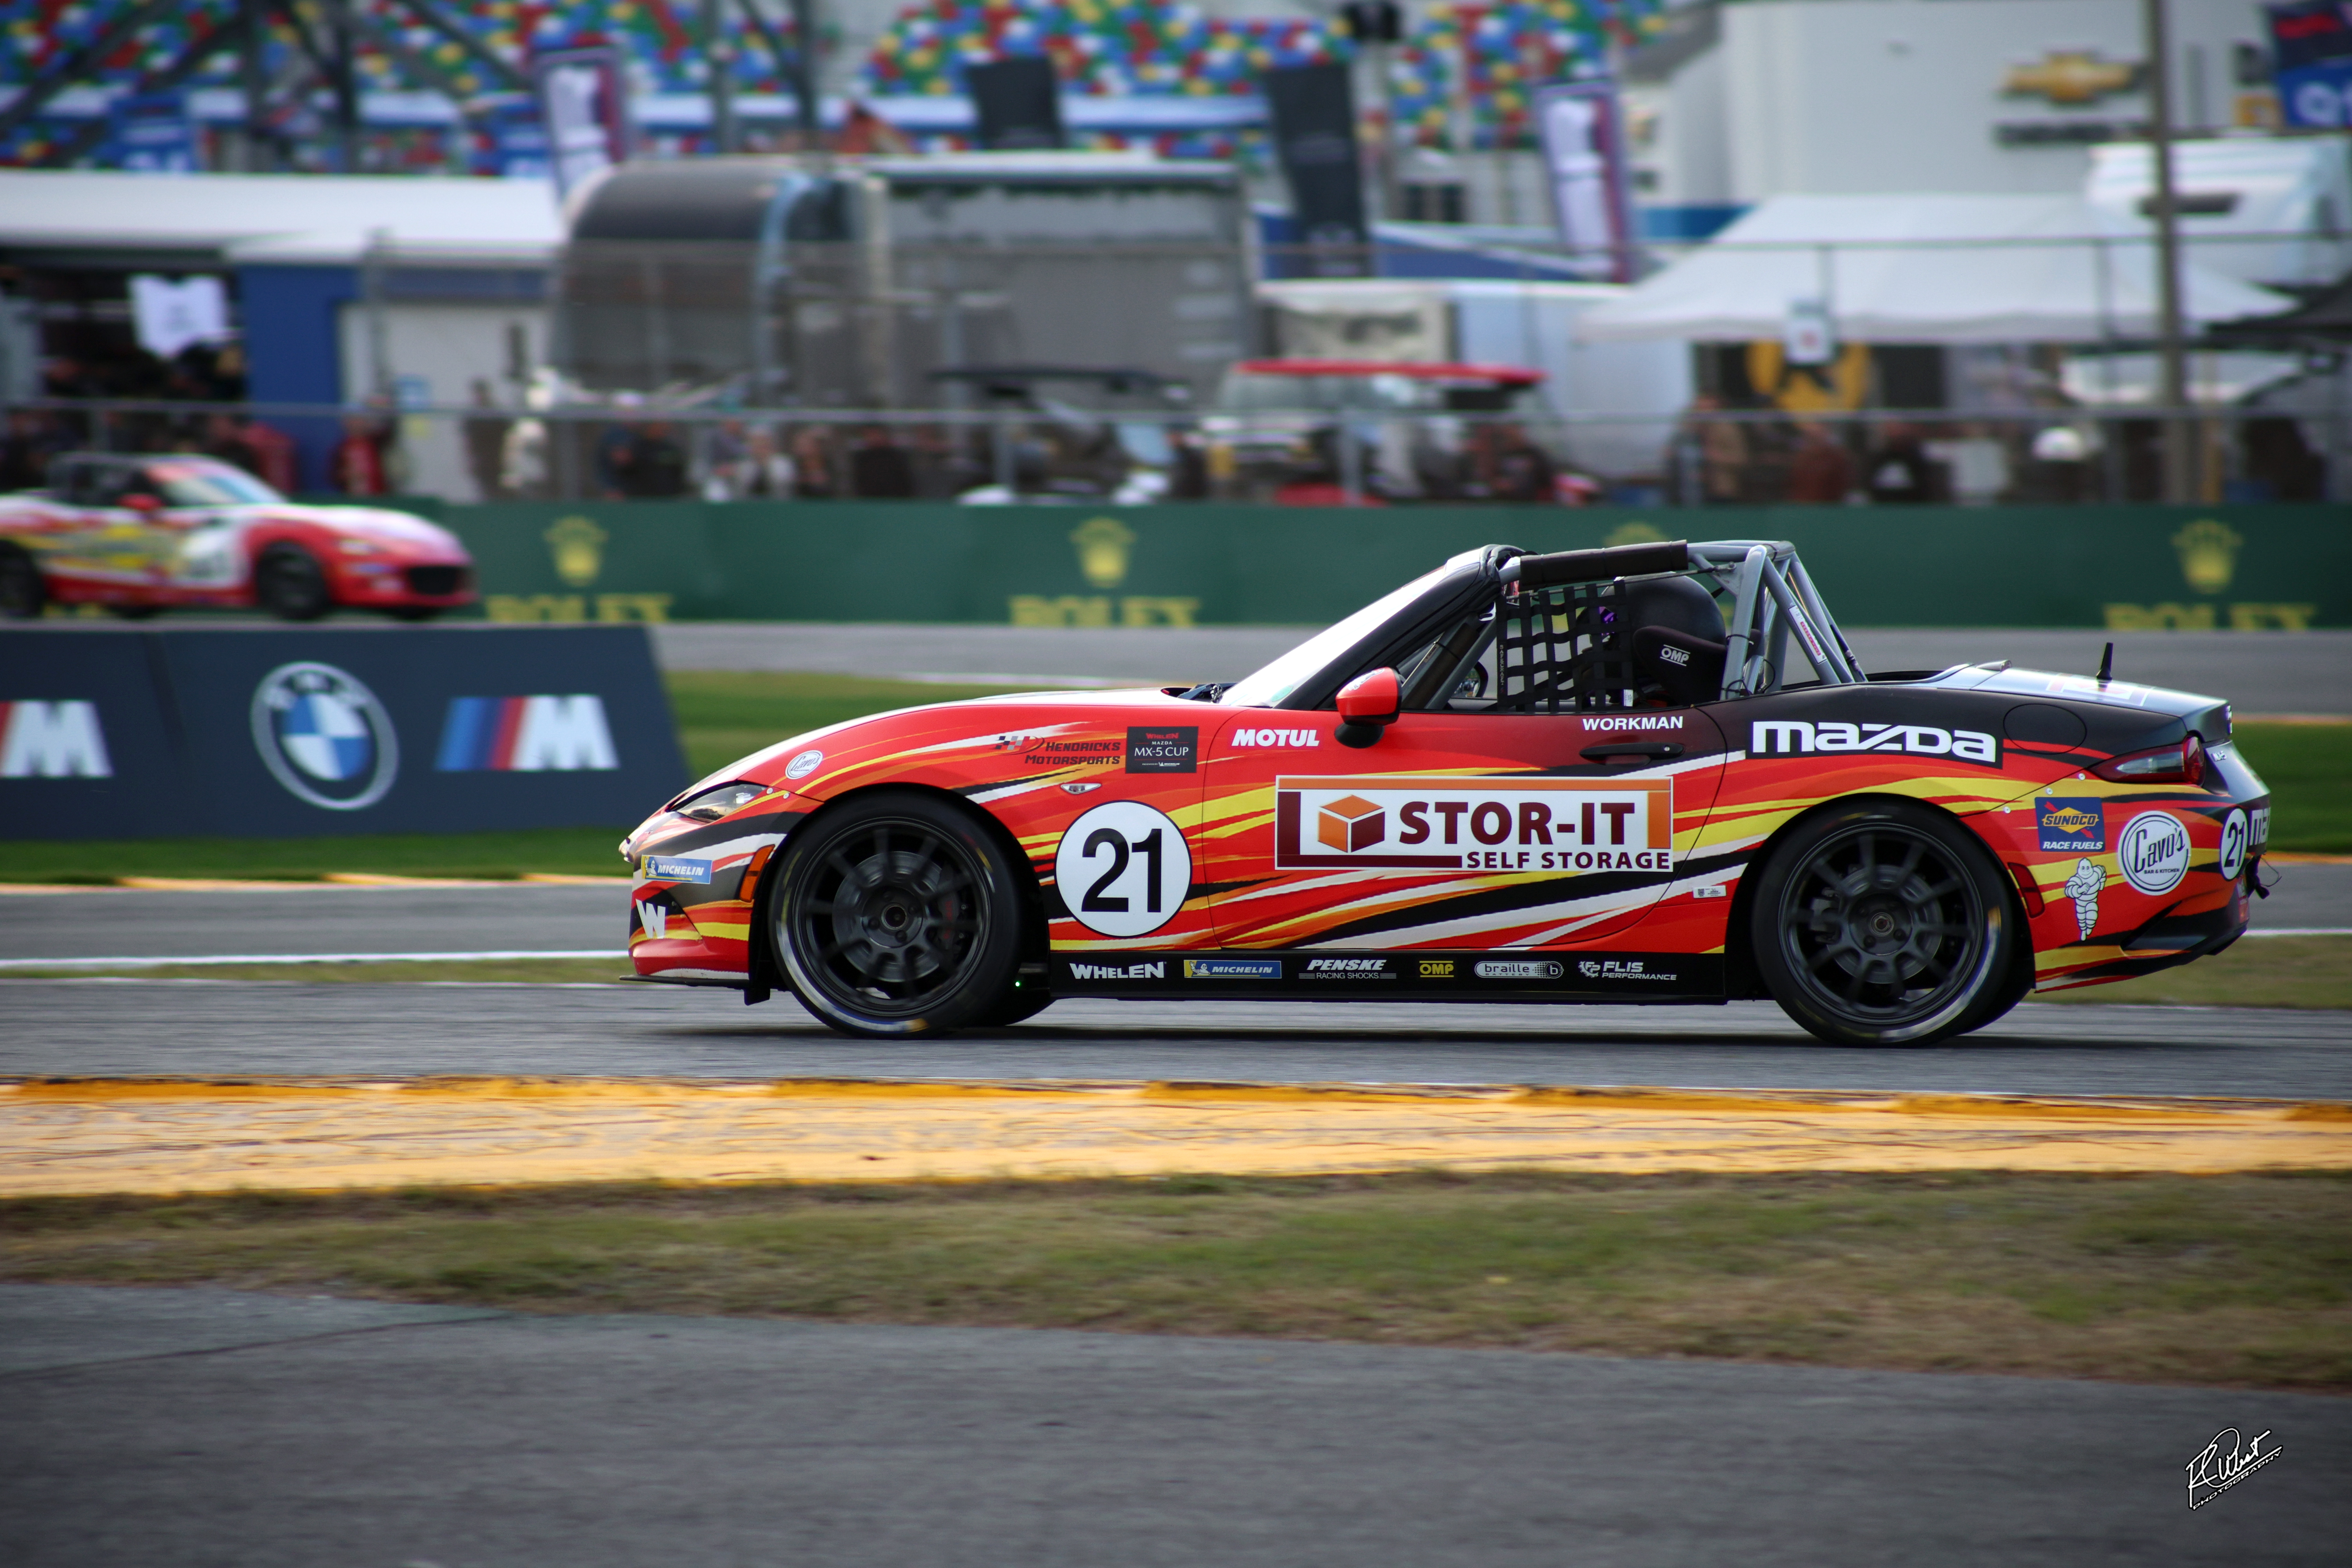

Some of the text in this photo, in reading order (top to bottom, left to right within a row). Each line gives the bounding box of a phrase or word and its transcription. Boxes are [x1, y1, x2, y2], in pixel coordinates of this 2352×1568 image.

[1661, 648, 1690, 663] OMP
[1583, 716, 1683, 730] WORKMAN
[1231, 729, 1320, 747] MOTUL
[1045, 742, 1121, 751] HENDRICKS
[1134, 747, 1189, 757] MX-5 CUP
[1025, 755, 1120, 765] MOTORSPORTS
[1399, 801, 1635, 845] STOR-IT
[2044, 815, 2098, 826] SUNOCO
[2043, 841, 2103, 849] RACE FUELS
[2134, 827, 2185, 873] Cavo's
[2223, 822, 2245, 868] 21
[1467, 851, 1670, 869] SELF STORAGE
[657, 865, 704, 876] MICHELIN
[1081, 828, 1162, 913] 21
[635, 898, 666, 939] W
[1069, 961, 1164, 979] WHELEN
[1307, 960, 1387, 970] PENSKE
[1419, 964, 1454, 975] OMP
[1485, 964, 1530, 973] braille
[1603, 961, 1644, 973] FLIS
